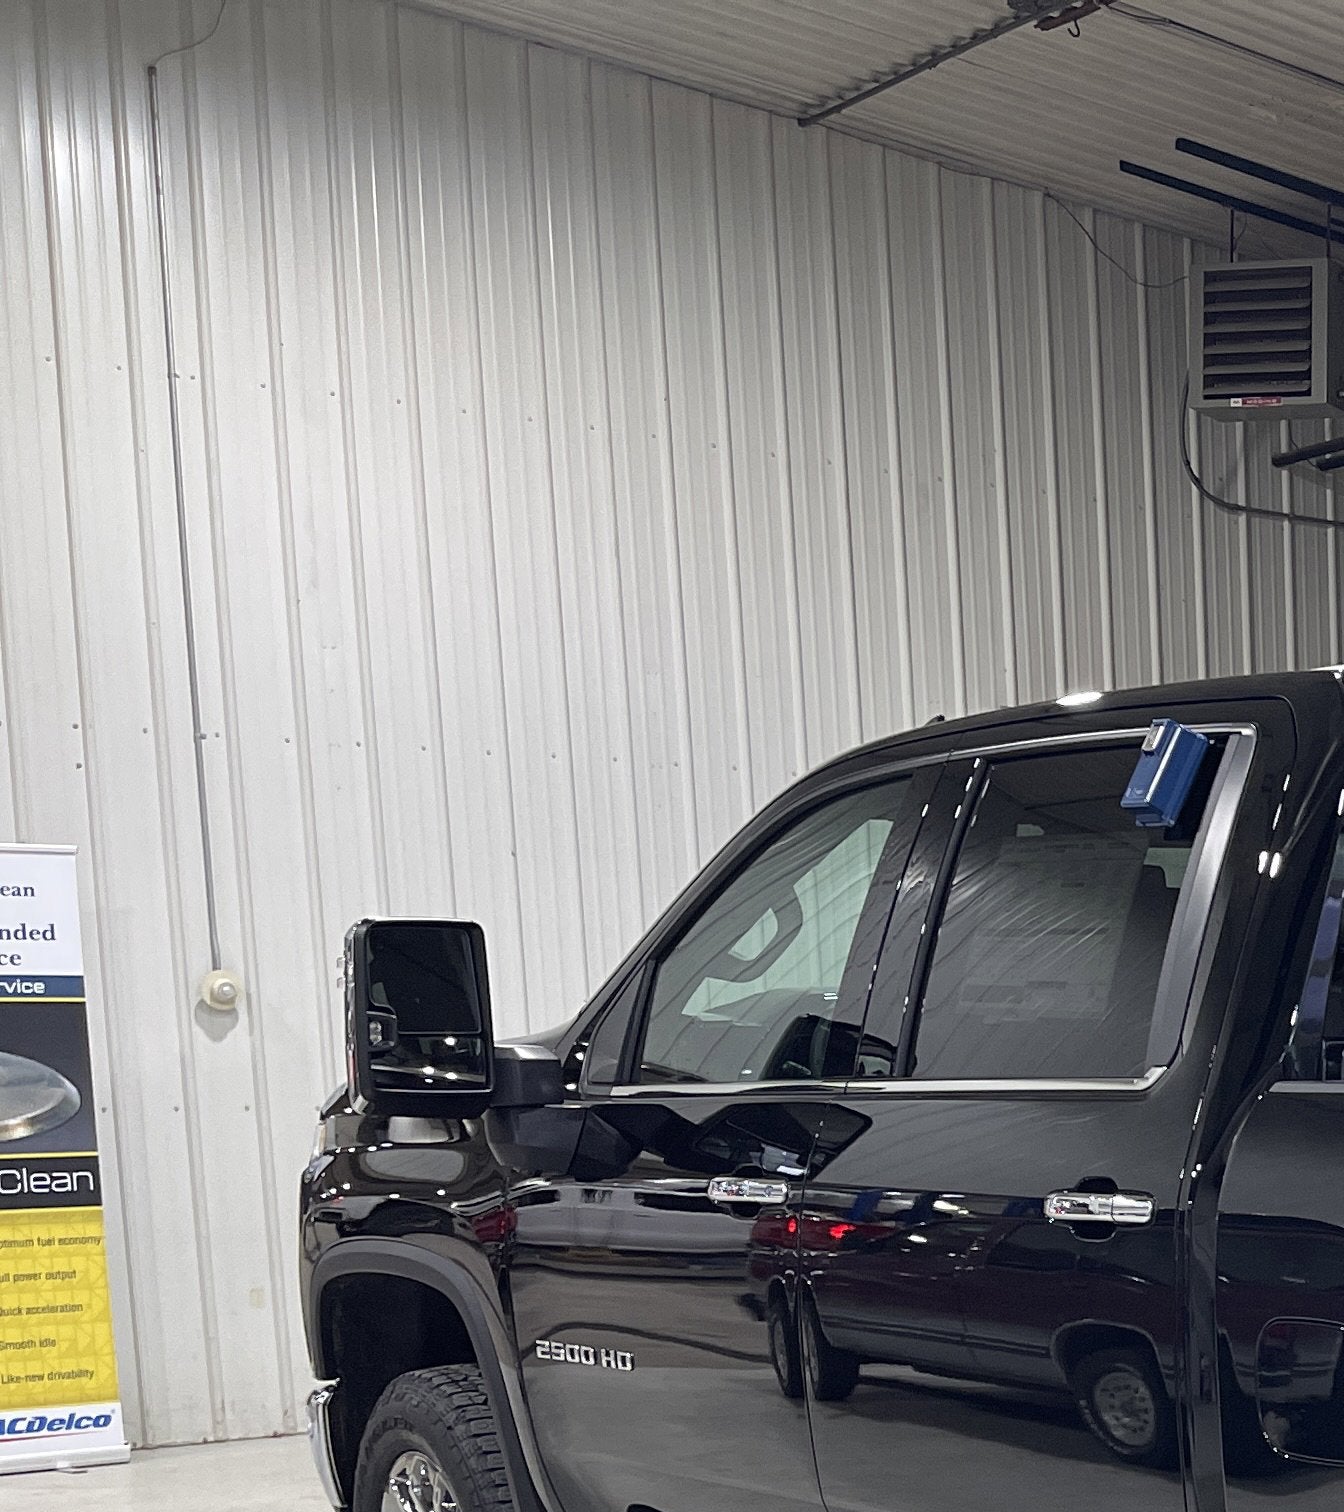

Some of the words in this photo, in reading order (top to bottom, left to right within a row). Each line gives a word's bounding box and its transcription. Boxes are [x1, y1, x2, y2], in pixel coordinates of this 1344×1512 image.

[0, 885, 35, 897] ean
[0, 1167, 94, 1194] Clean
[0, 1239, 35, 1249] ptimum
[37, 1236, 55, 1247] fuel
[58, 1235, 102, 1246] economy
[0, 1272, 10, 1282] ull
[13, 1272, 42, 1283] power
[45, 1269, 77, 1281] output
[25, 1303, 83, 1315] acceleration
[39, 1338, 57, 1348] idle
[535, 1339, 596, 1366] 2500
[601, 1347, 634, 1371] HD
[1, 1373, 45, 1385] Like-new
[47, 1368, 95, 1381] drivability
